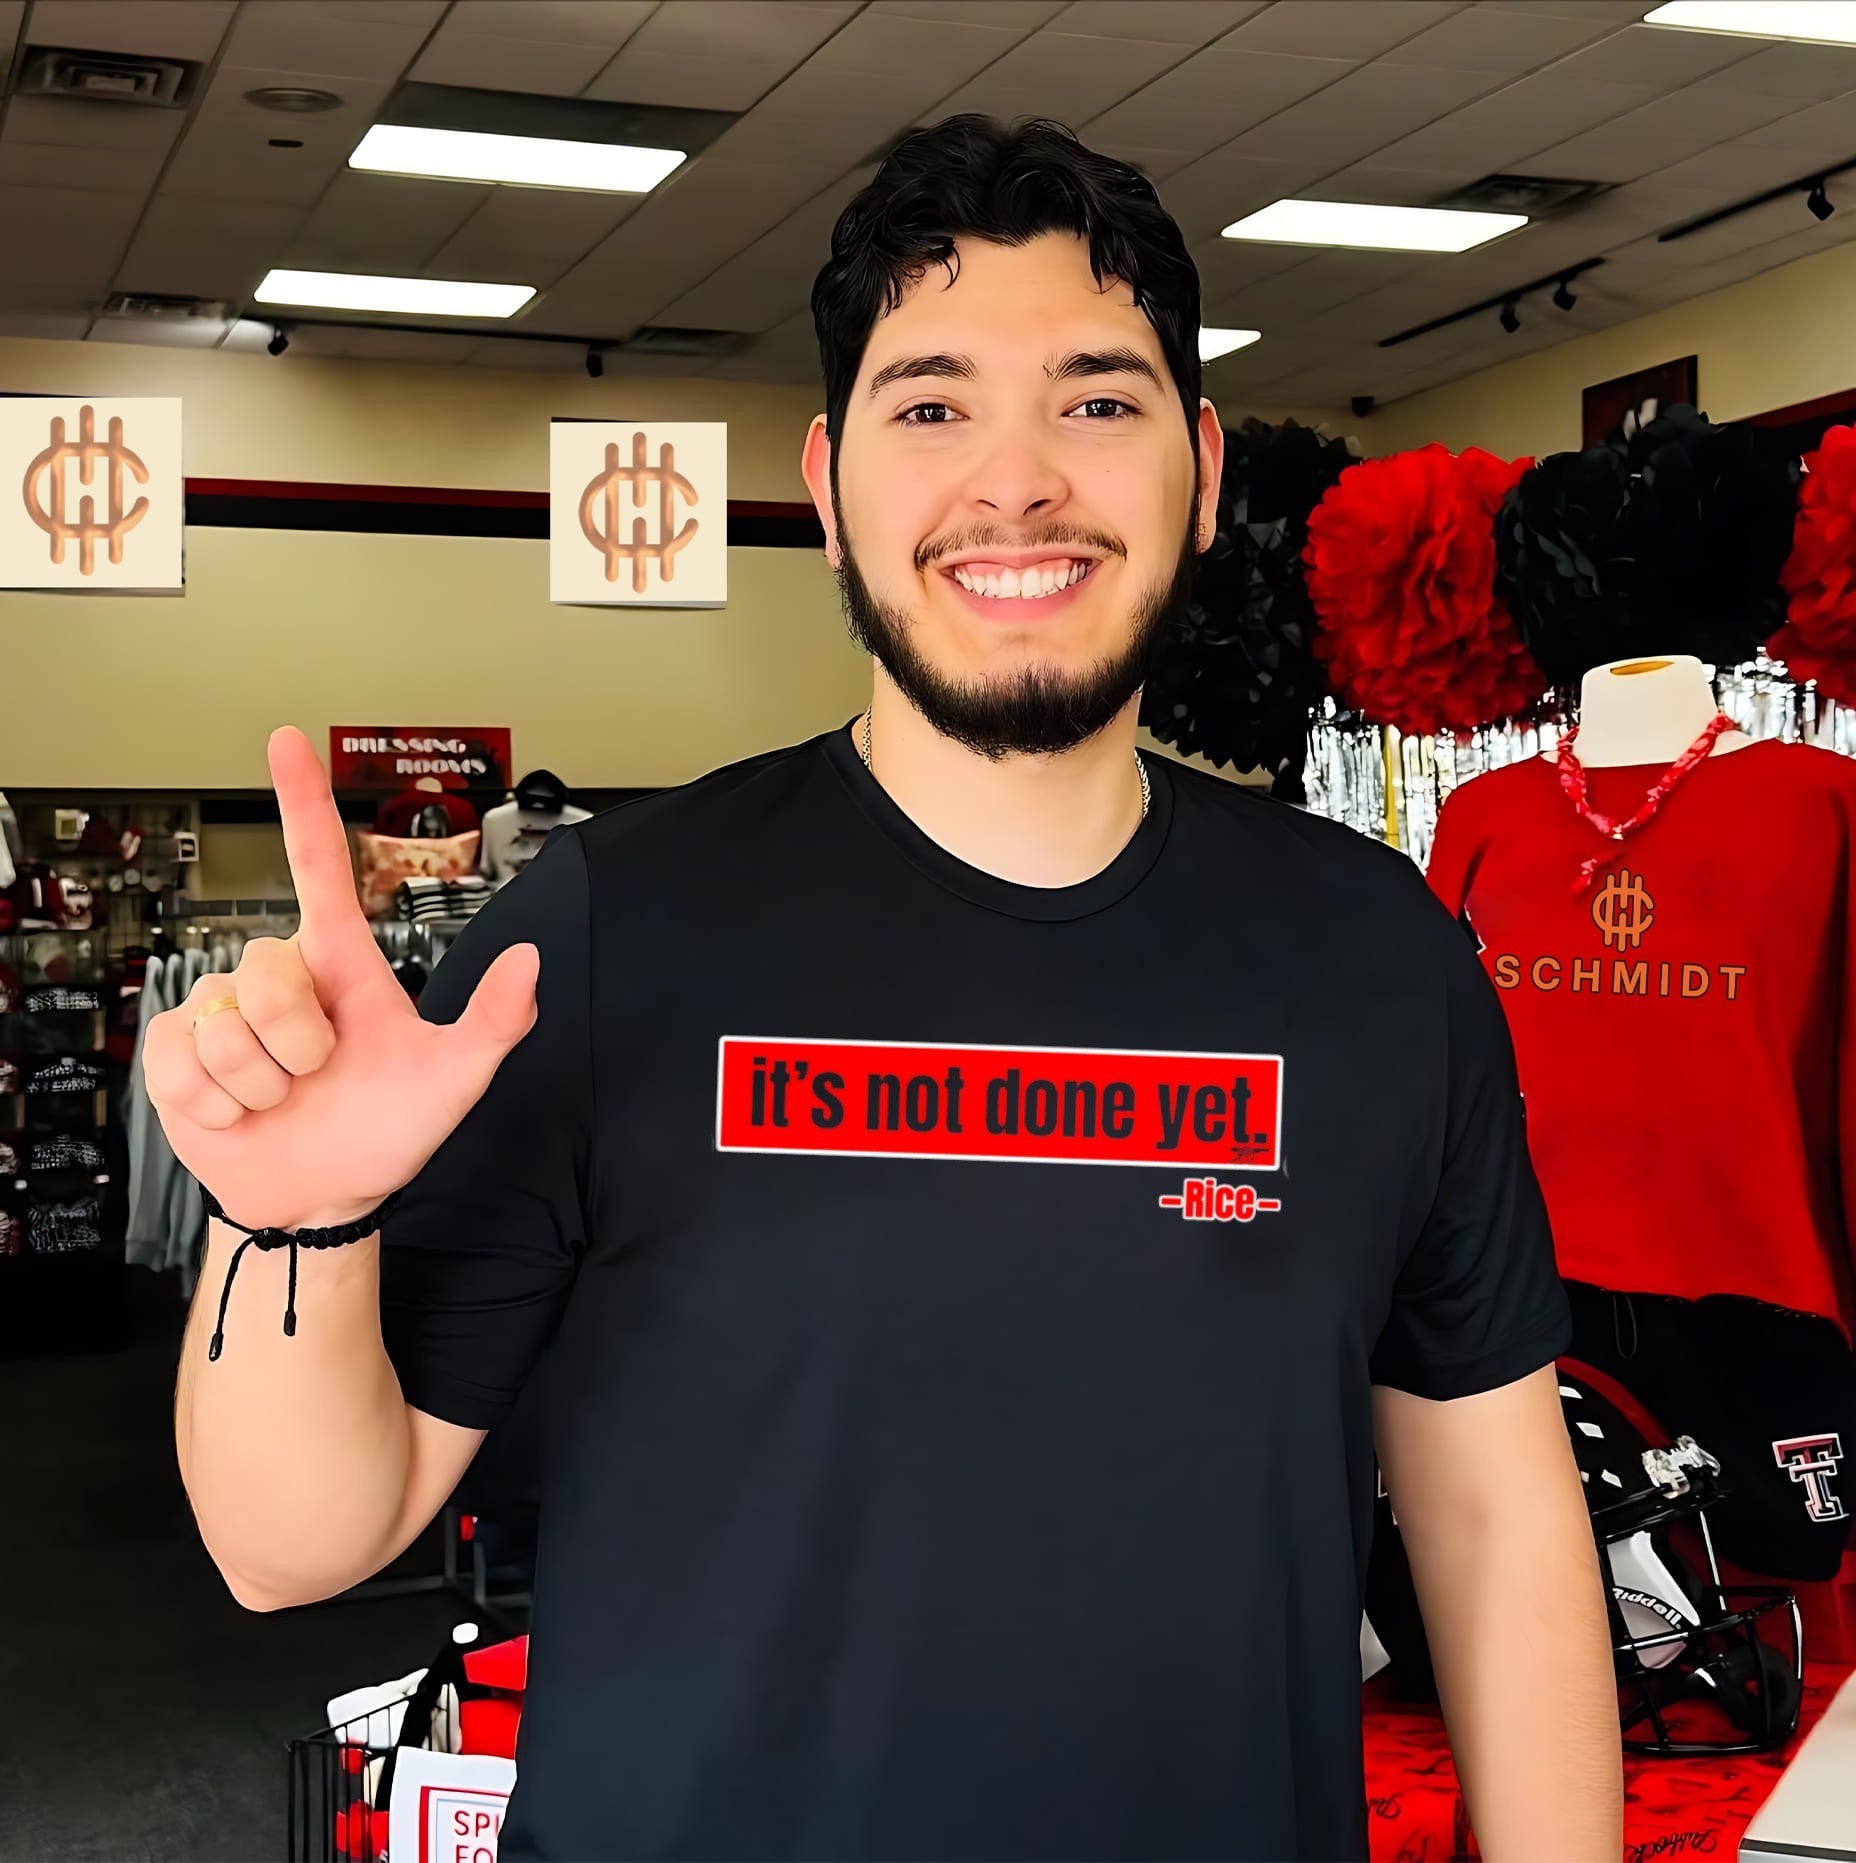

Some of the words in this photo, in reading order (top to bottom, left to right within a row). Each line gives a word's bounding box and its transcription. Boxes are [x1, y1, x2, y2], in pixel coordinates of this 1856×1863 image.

[342, 737, 467, 754] DRESSING
[396, 758, 487, 774] ROOMS
[1494, 954, 1746, 1001] SCHMIDT
[750, 1056, 845, 1129] it's
[866, 1066, 965, 1134] not
[985, 1068, 1135, 1139] done
[1155, 1076, 1269, 1150] yet.
